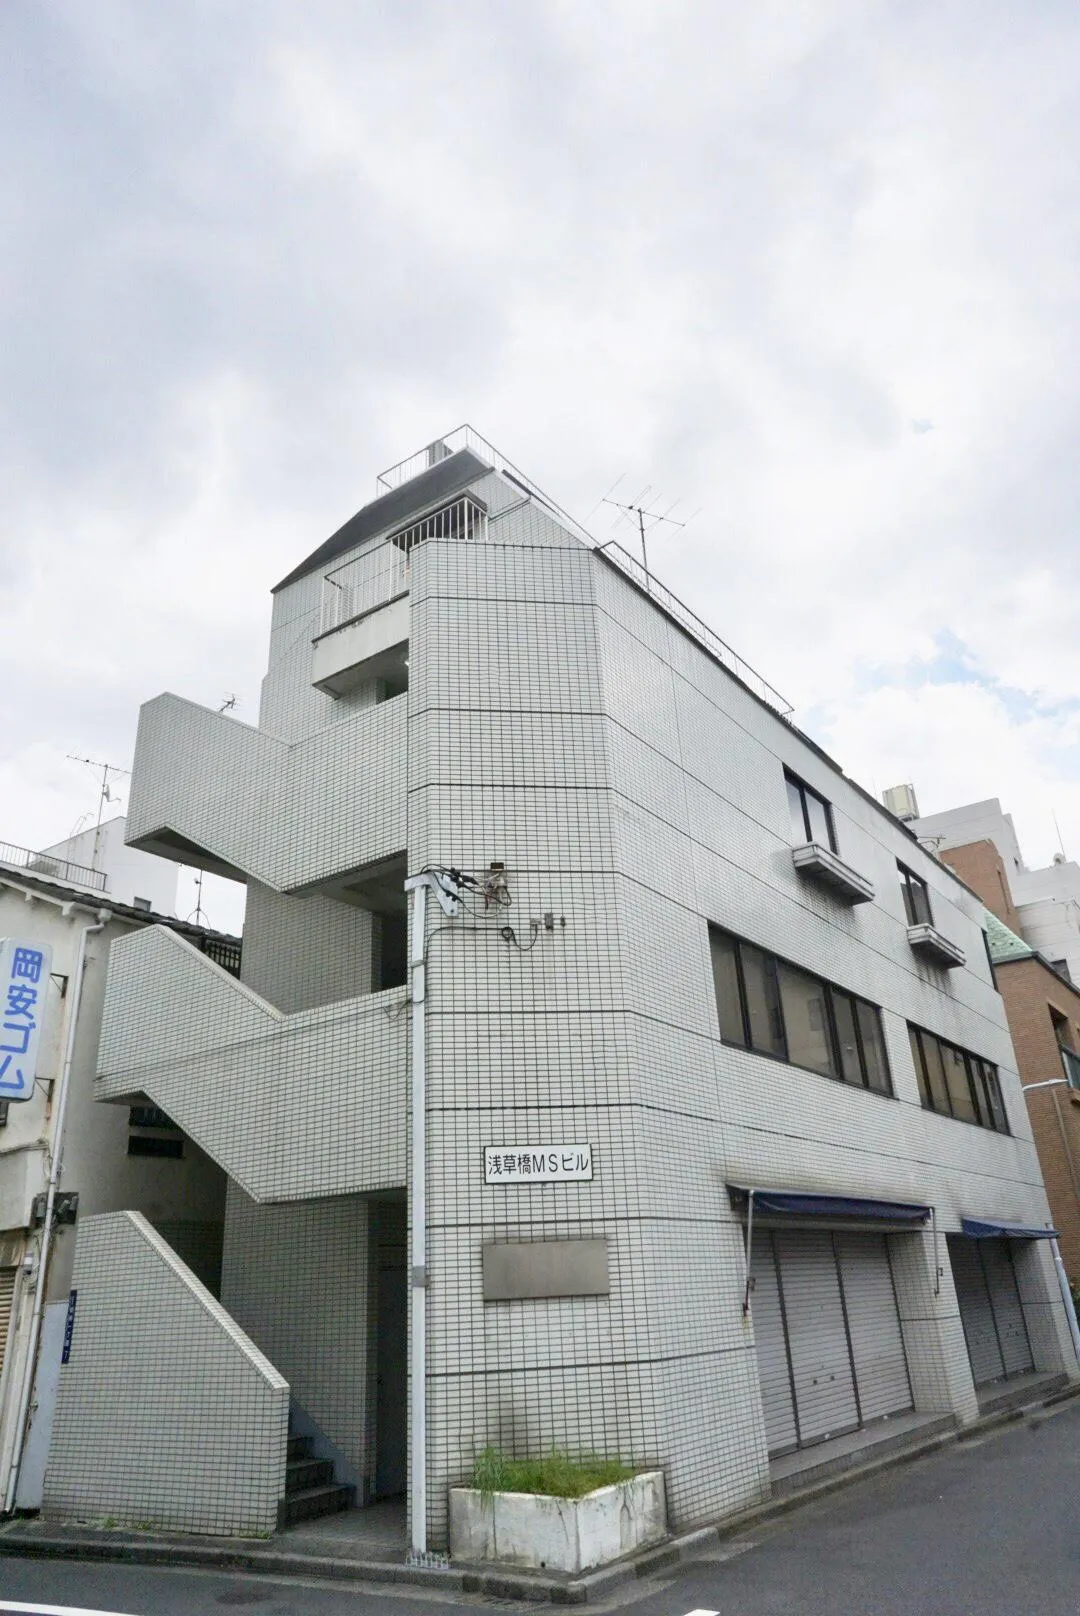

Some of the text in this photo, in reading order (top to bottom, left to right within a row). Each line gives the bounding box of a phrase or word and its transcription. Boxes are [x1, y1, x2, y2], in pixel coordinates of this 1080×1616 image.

[0, 947, 43, 1090] 岡安ゴム
[488, 1152, 589, 1175] 浅草橋MSビル
